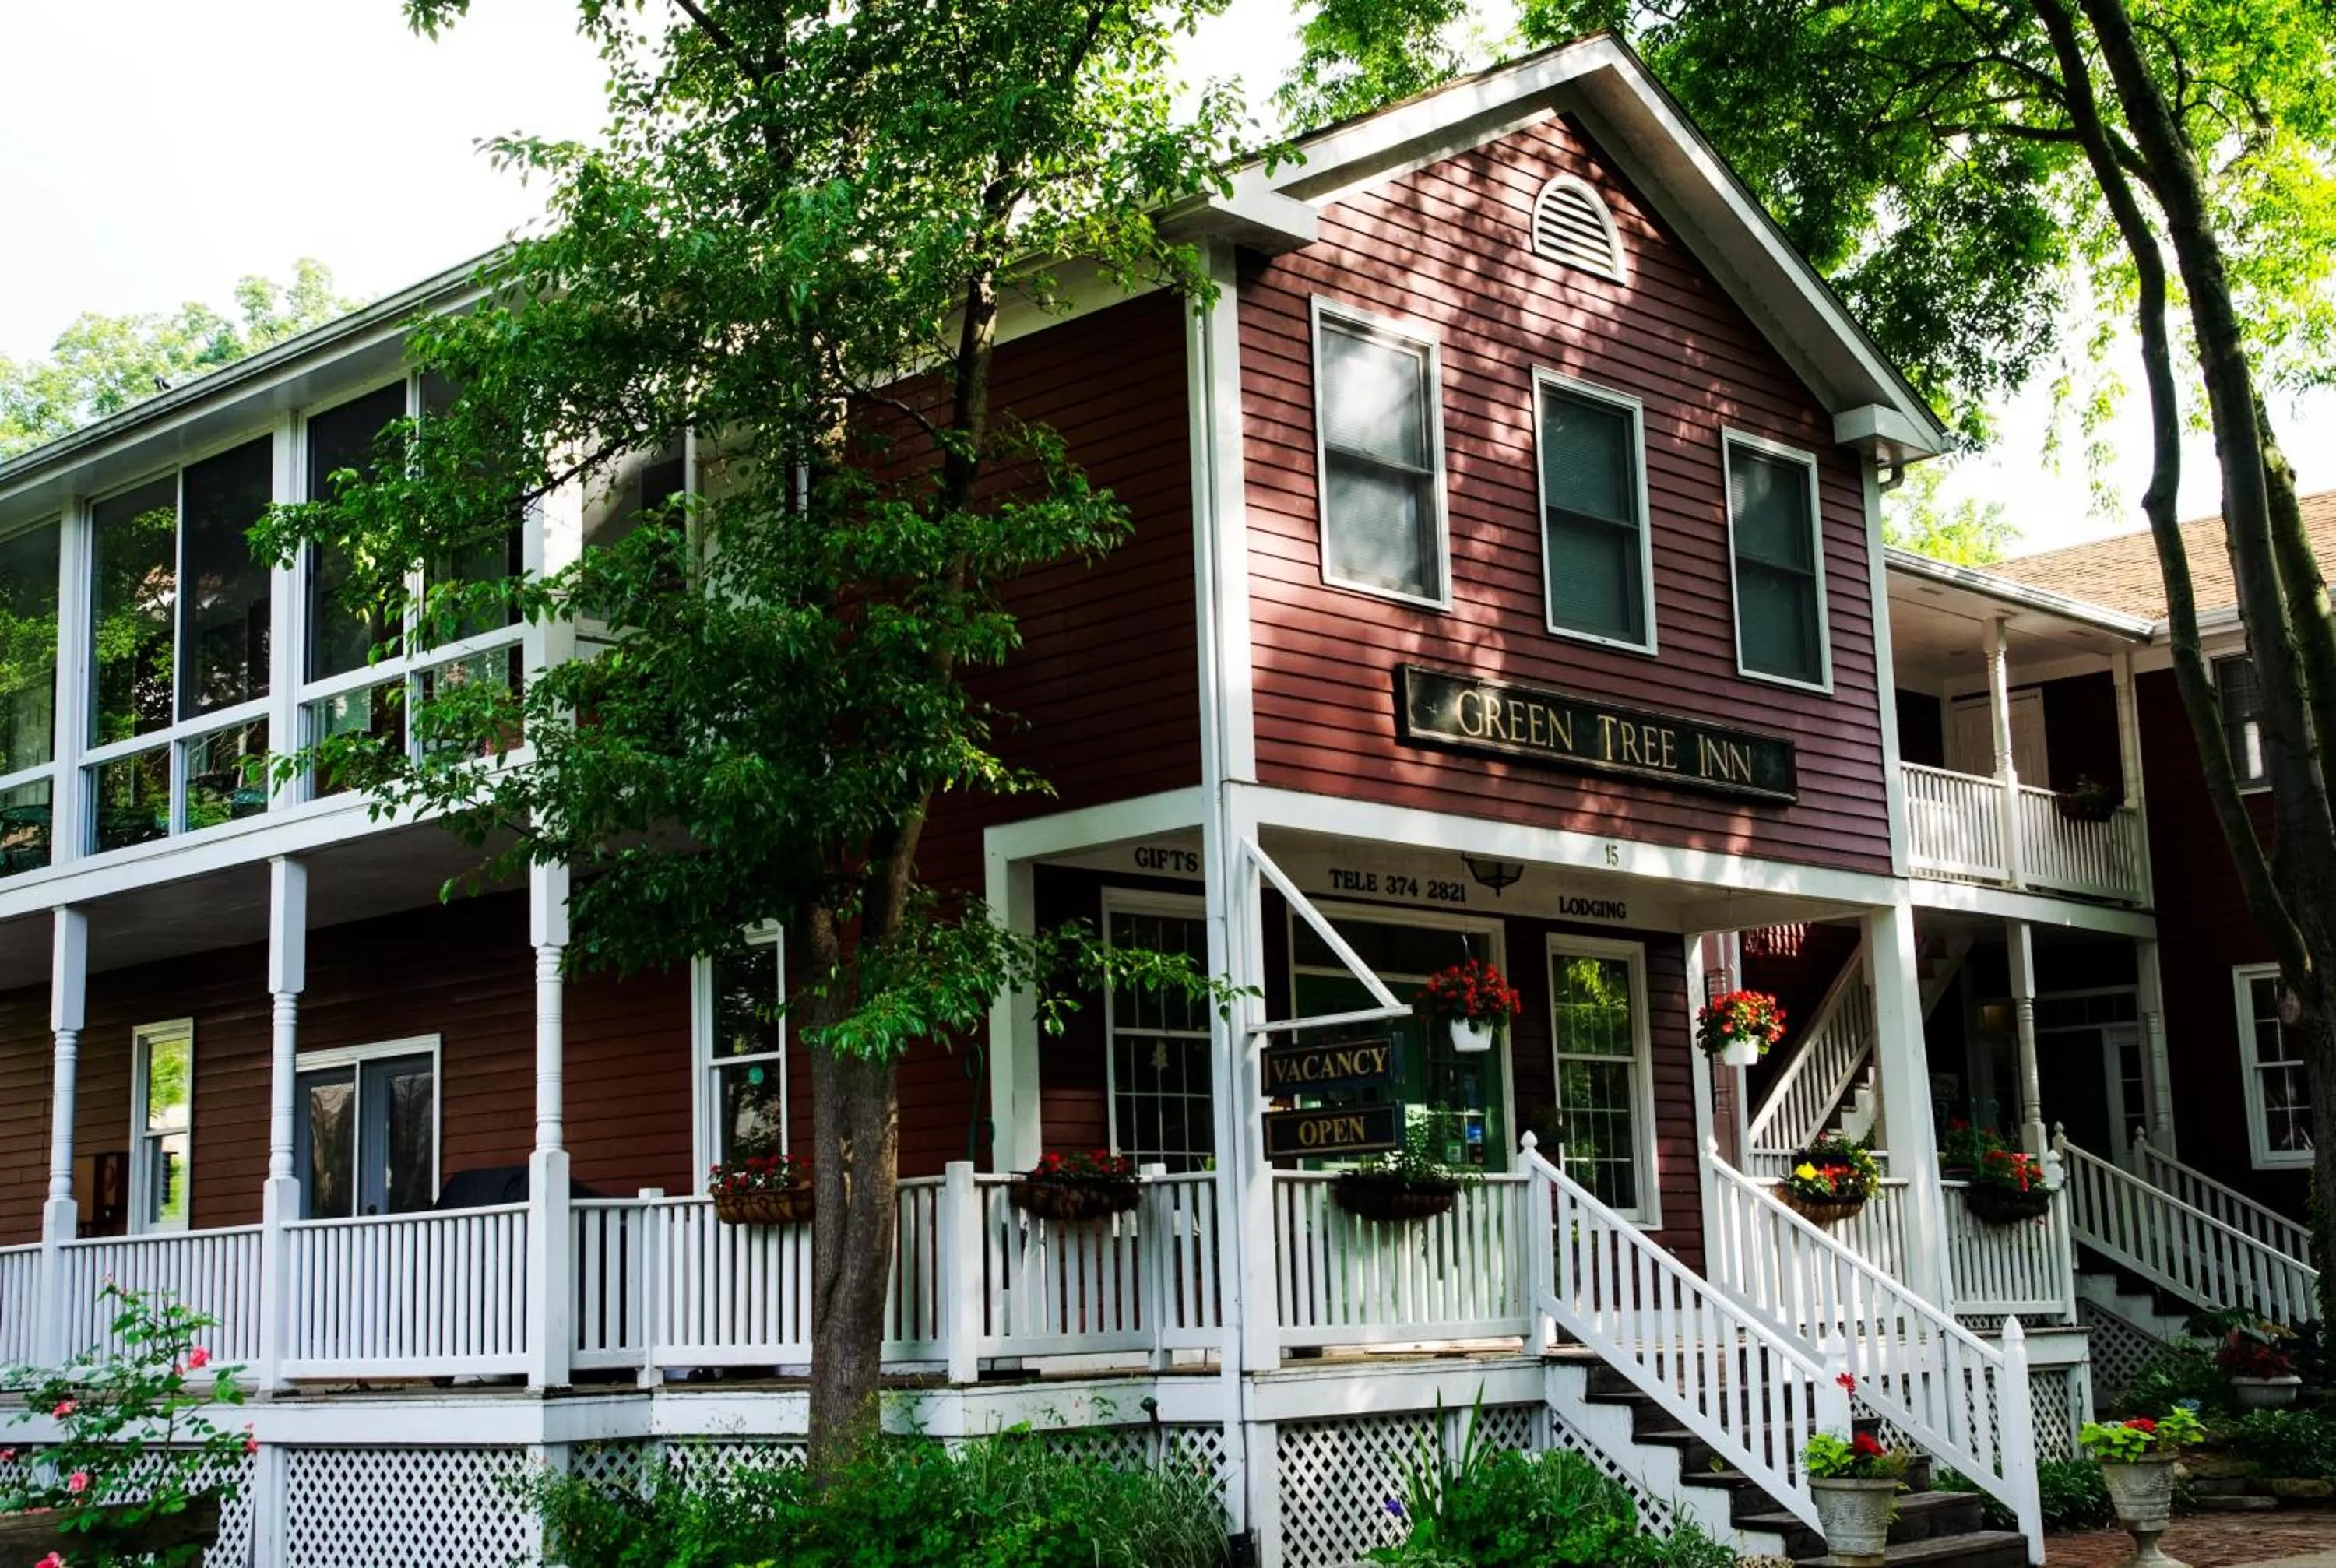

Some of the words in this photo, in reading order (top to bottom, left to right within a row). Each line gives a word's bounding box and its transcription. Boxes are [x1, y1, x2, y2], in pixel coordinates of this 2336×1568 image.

[1456, 690, 1573, 752] GREEN
[1597, 713, 1679, 770] TREE
[1697, 733, 1752, 782] INN
[1135, 846, 1198, 872] GIFTS
[1605, 843, 1619, 866] 15
[1329, 868, 1377, 892] TELE
[1386, 875, 1418, 897] 374
[1427, 880, 1466, 902] 2821
[1558, 895, 1627, 919] LODGING
[1272, 1047, 1388, 1083] VACANCY
[1298, 1116, 1366, 1147] OPEN
